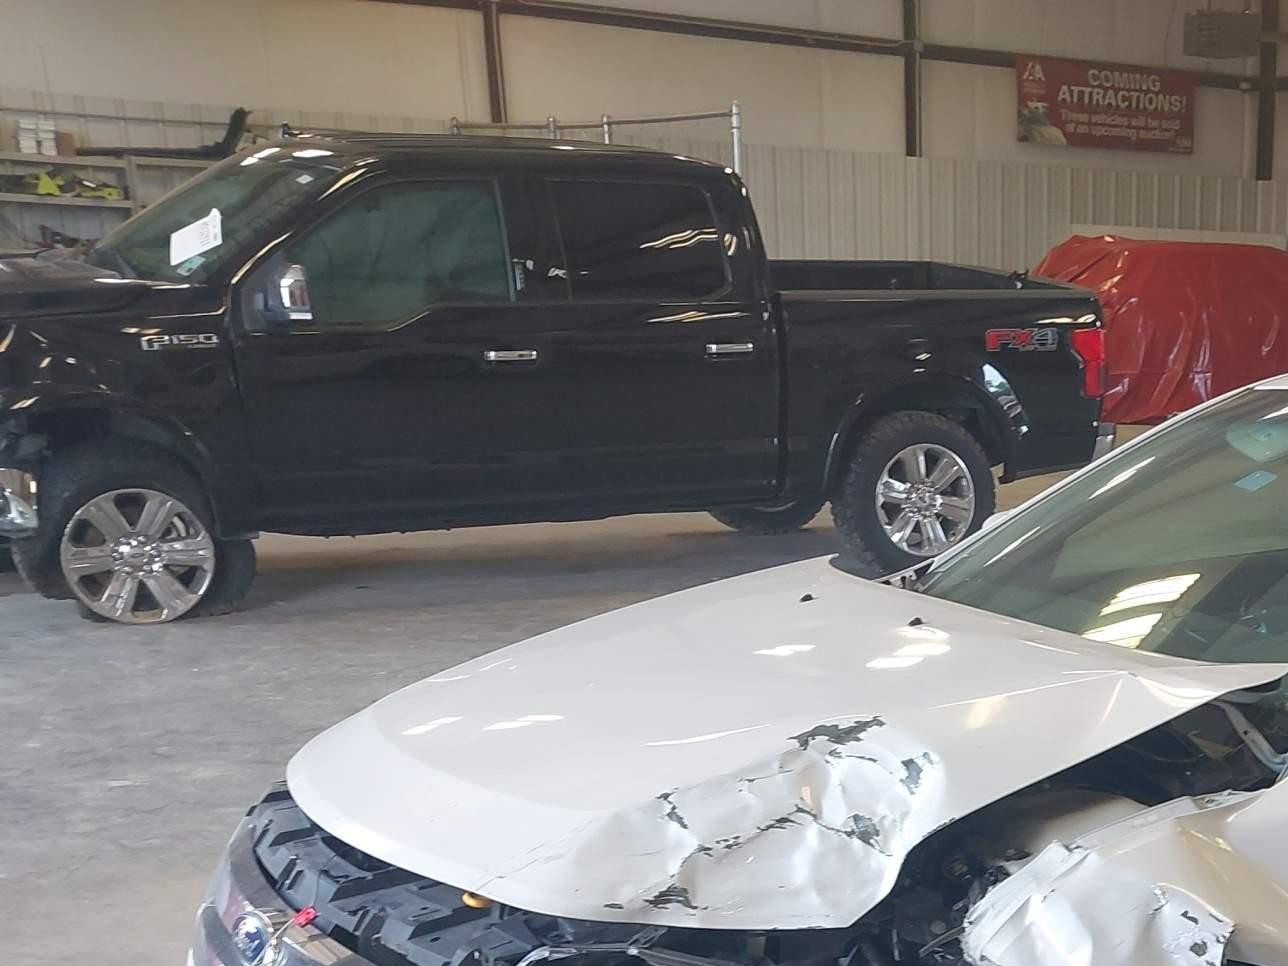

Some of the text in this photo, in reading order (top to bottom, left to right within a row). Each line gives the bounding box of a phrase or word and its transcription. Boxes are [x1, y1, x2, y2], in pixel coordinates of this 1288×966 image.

[1087, 68, 1161, 92] COMING
[1057, 84, 1187, 113] ATTRACTIONS!
[1130, 113, 1146, 127] will
[1147, 116, 1161, 128] be
[1091, 125, 1137, 141] upcoming
[985, 327, 1058, 352] FX4
